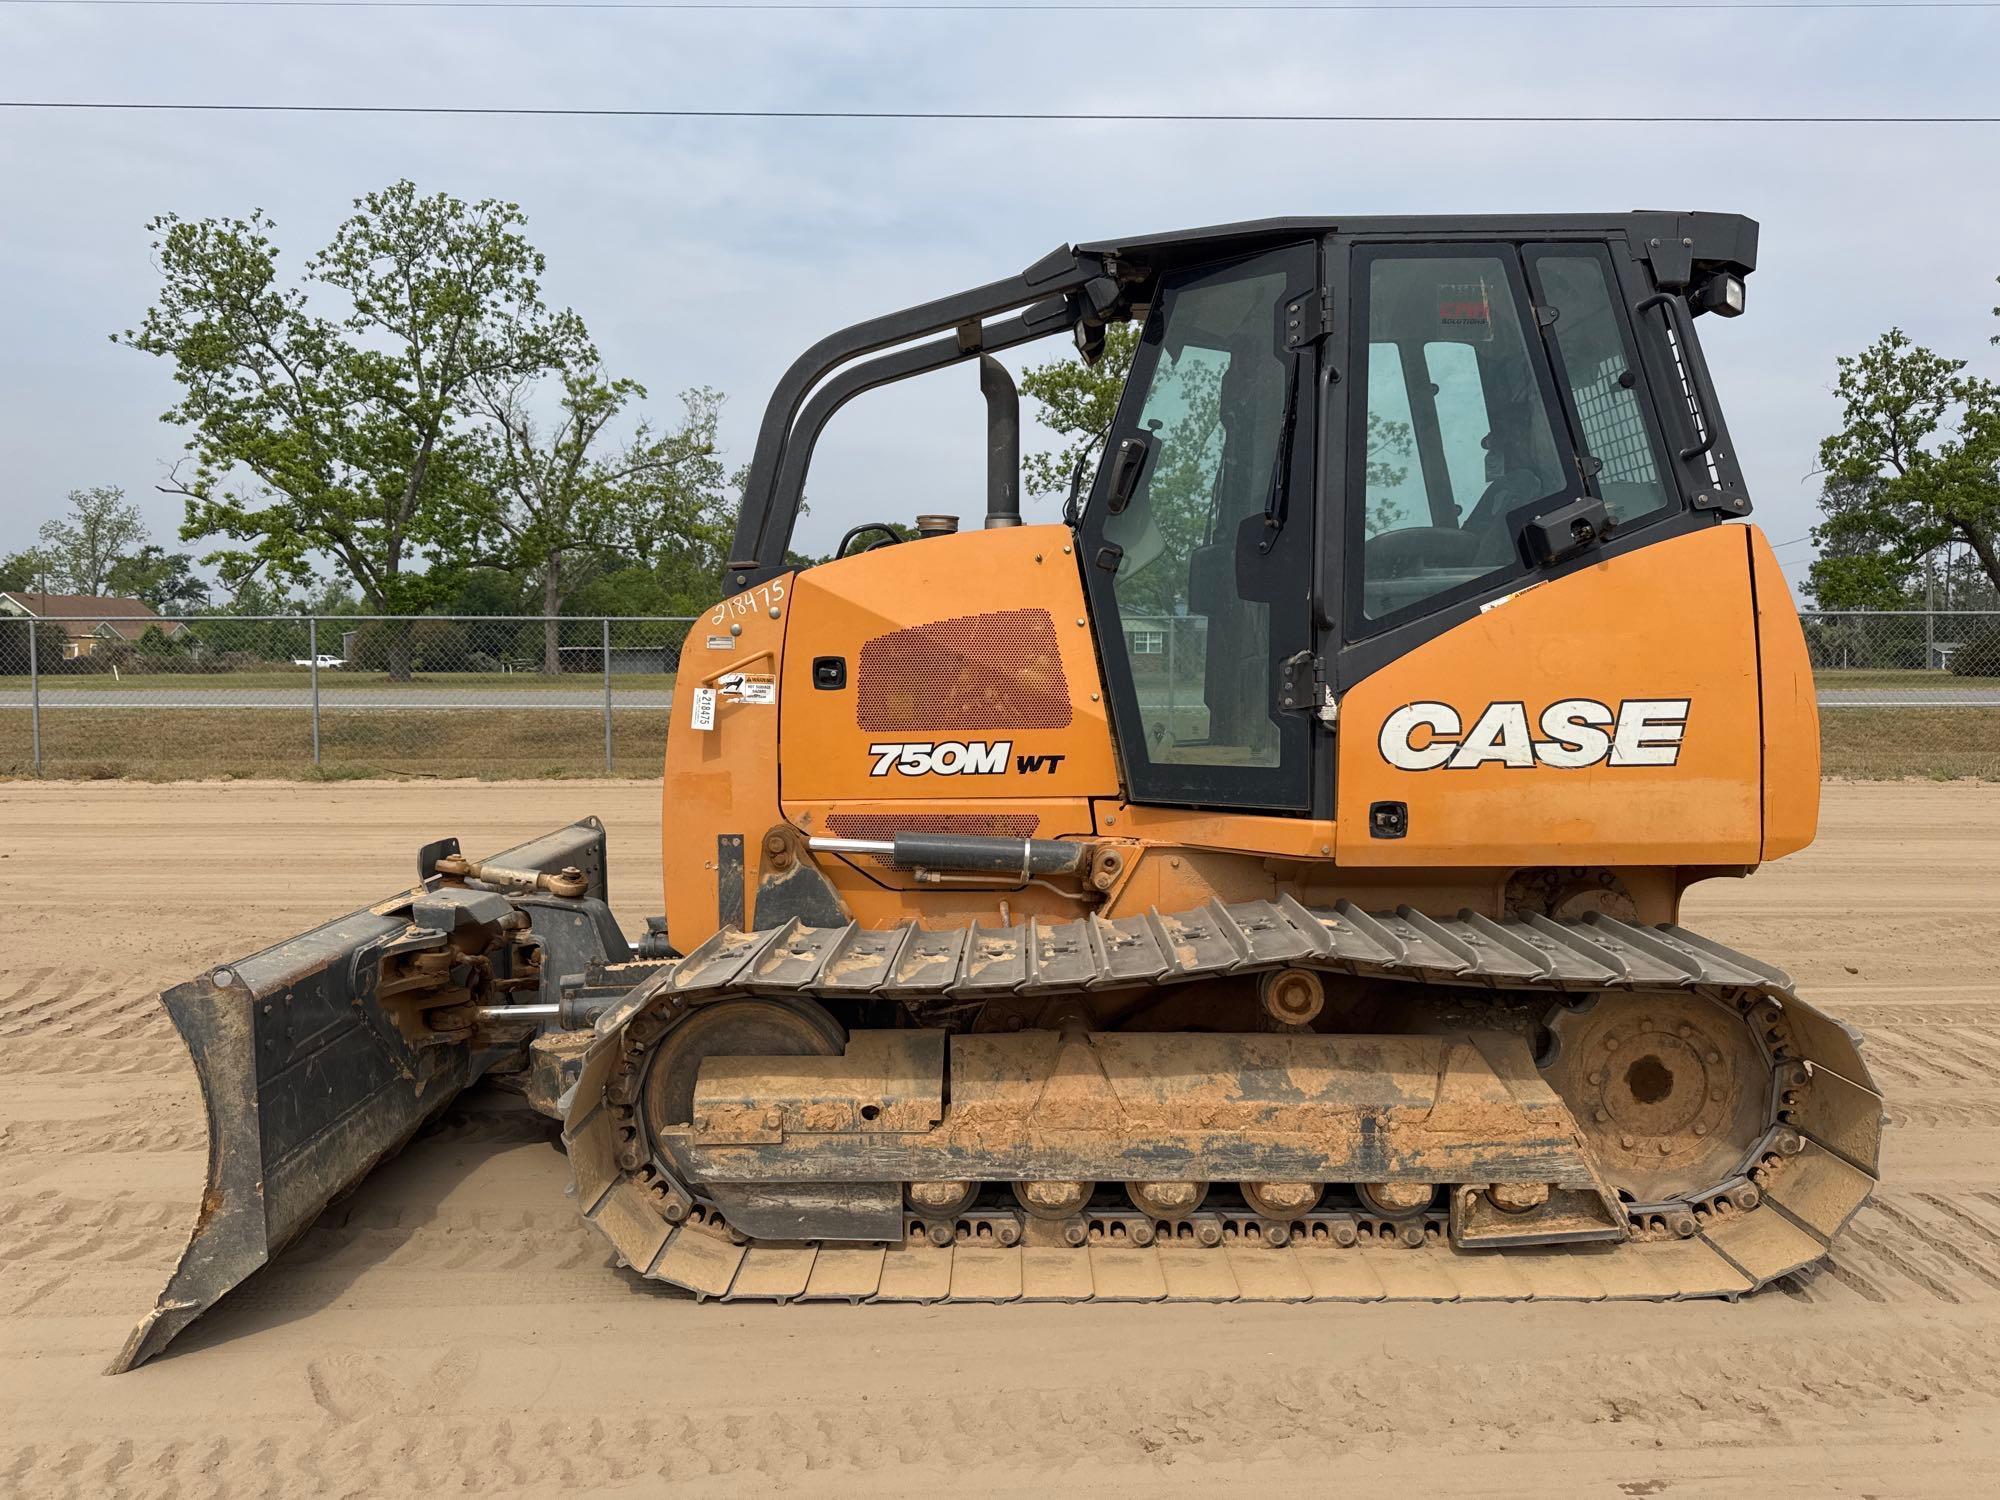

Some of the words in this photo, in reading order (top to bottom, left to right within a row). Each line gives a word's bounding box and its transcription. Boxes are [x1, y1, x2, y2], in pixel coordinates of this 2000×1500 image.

[712, 580, 784, 625] 218475
[699, 696, 712, 725] 218475
[1378, 698, 1692, 772] CASE
[868, 740, 1014, 777] 750M
[1017, 755, 1066, 775] WT
